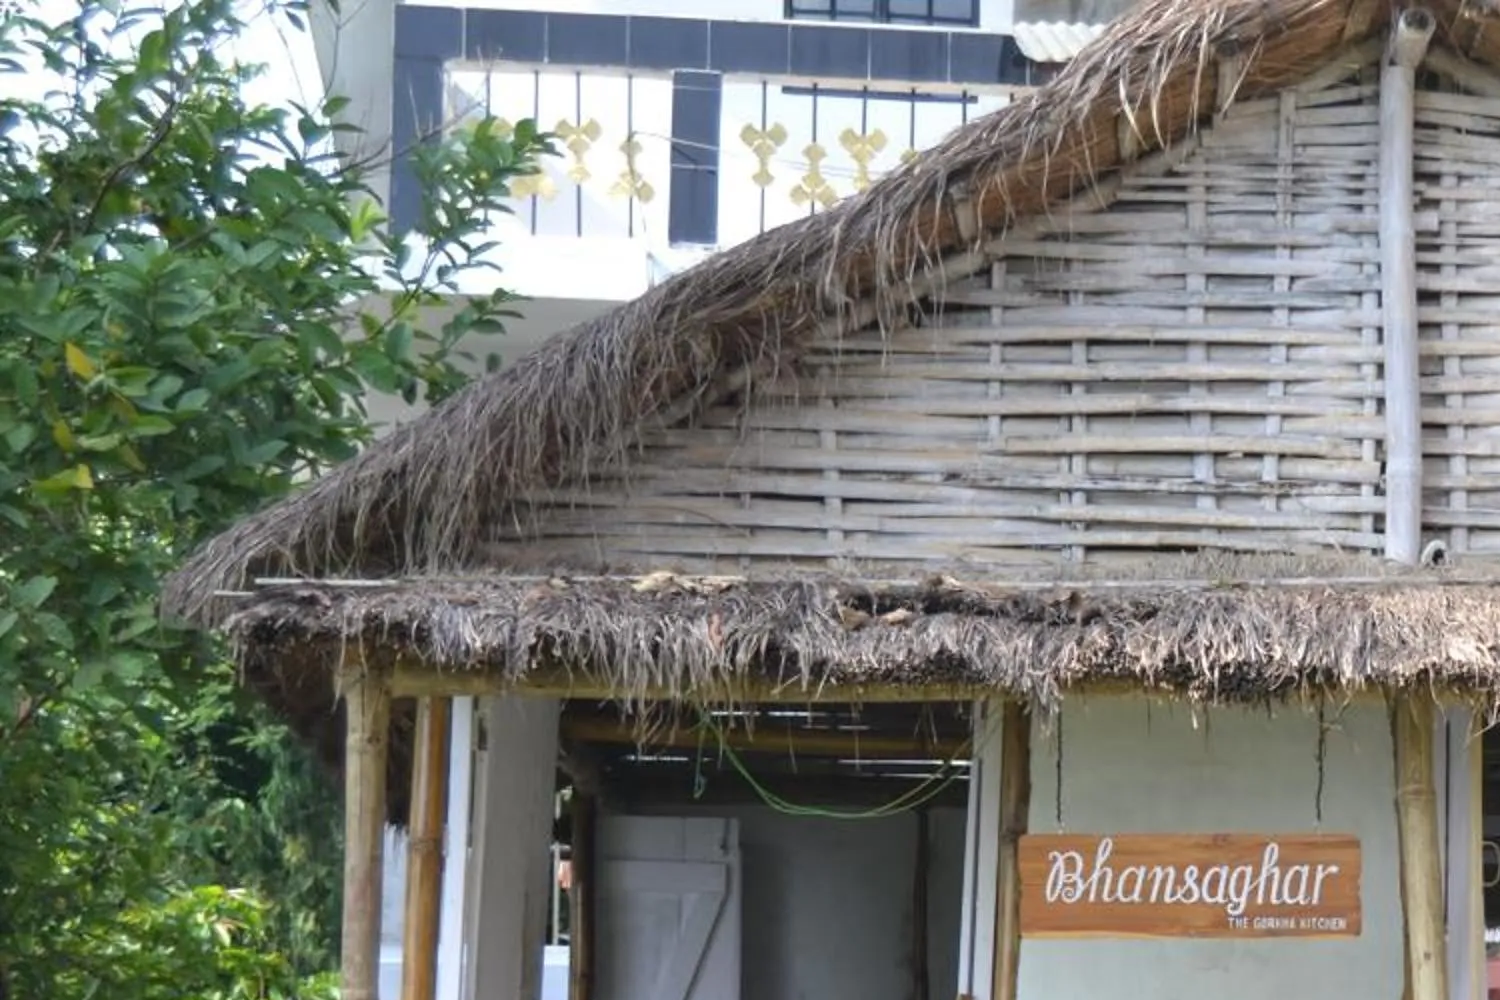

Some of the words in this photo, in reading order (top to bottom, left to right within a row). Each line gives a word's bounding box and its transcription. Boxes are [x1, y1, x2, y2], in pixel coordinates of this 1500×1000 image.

[1045, 837, 1340, 915] Bhansaghar
[1228, 917, 1249, 930] THE
[1301, 917, 1347, 930] KITCHEN
